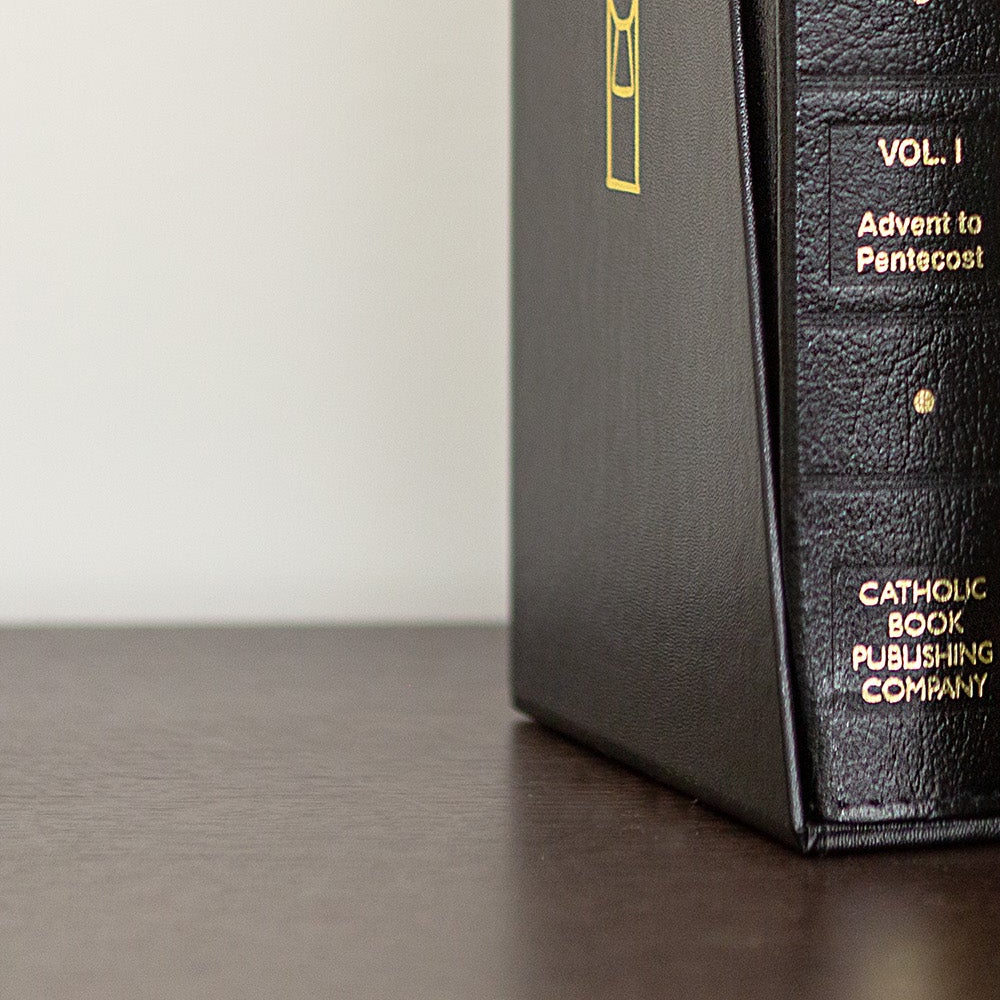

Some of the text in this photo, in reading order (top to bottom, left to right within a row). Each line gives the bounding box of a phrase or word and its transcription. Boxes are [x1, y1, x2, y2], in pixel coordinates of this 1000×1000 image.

[877, 136, 963, 167] VOL. I
[857, 210, 983, 238] Advent to
[856, 245, 984, 273] Pentecost
[858, 575, 987, 606] CATHOLIC
[887, 609, 964, 639] BOOK
[852, 640, 994, 672] PUBLISHING
[861, 672, 988, 704] COMPANY
